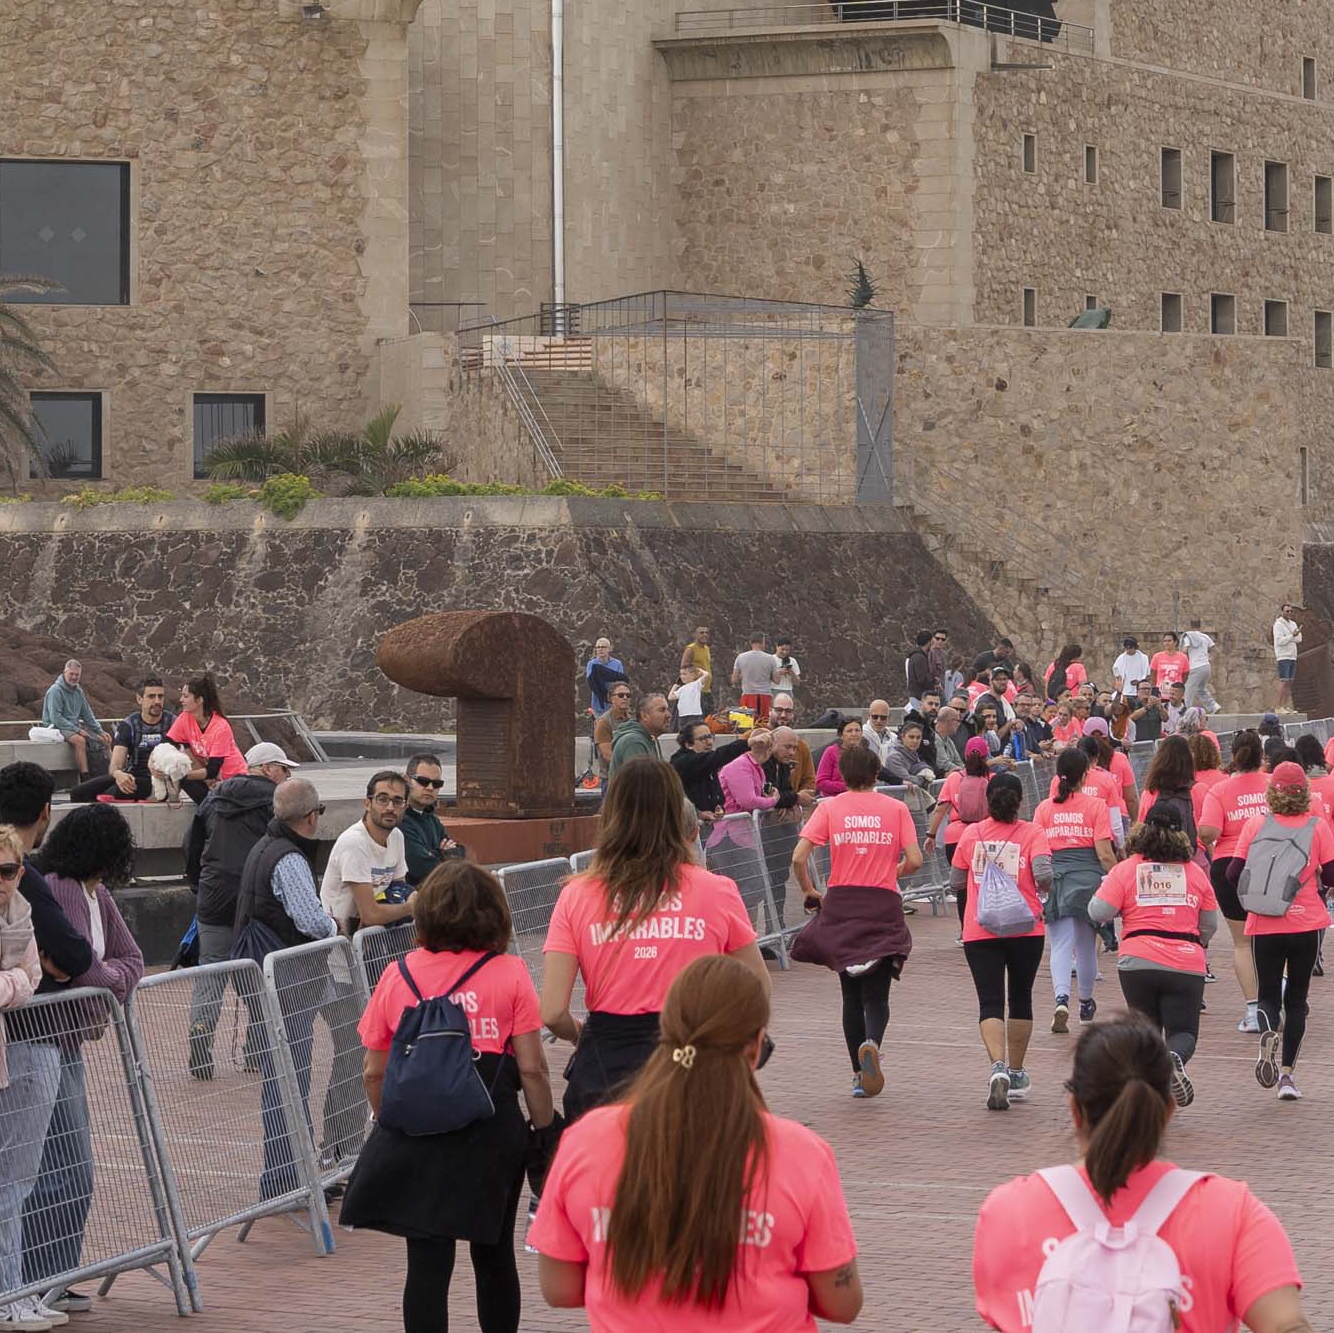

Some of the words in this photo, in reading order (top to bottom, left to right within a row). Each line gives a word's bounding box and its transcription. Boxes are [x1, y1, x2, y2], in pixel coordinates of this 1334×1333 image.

[1081, 786, 1098, 796] MOS
[844, 816, 881, 829] SOMOS
[1053, 812, 1084, 824] SOMOS
[833, 831, 893, 846] IMPARABLES
[1043, 827, 1093, 838] IMPARABLES
[1153, 881, 1172, 890] 016
[634, 946, 658, 959] 2026
